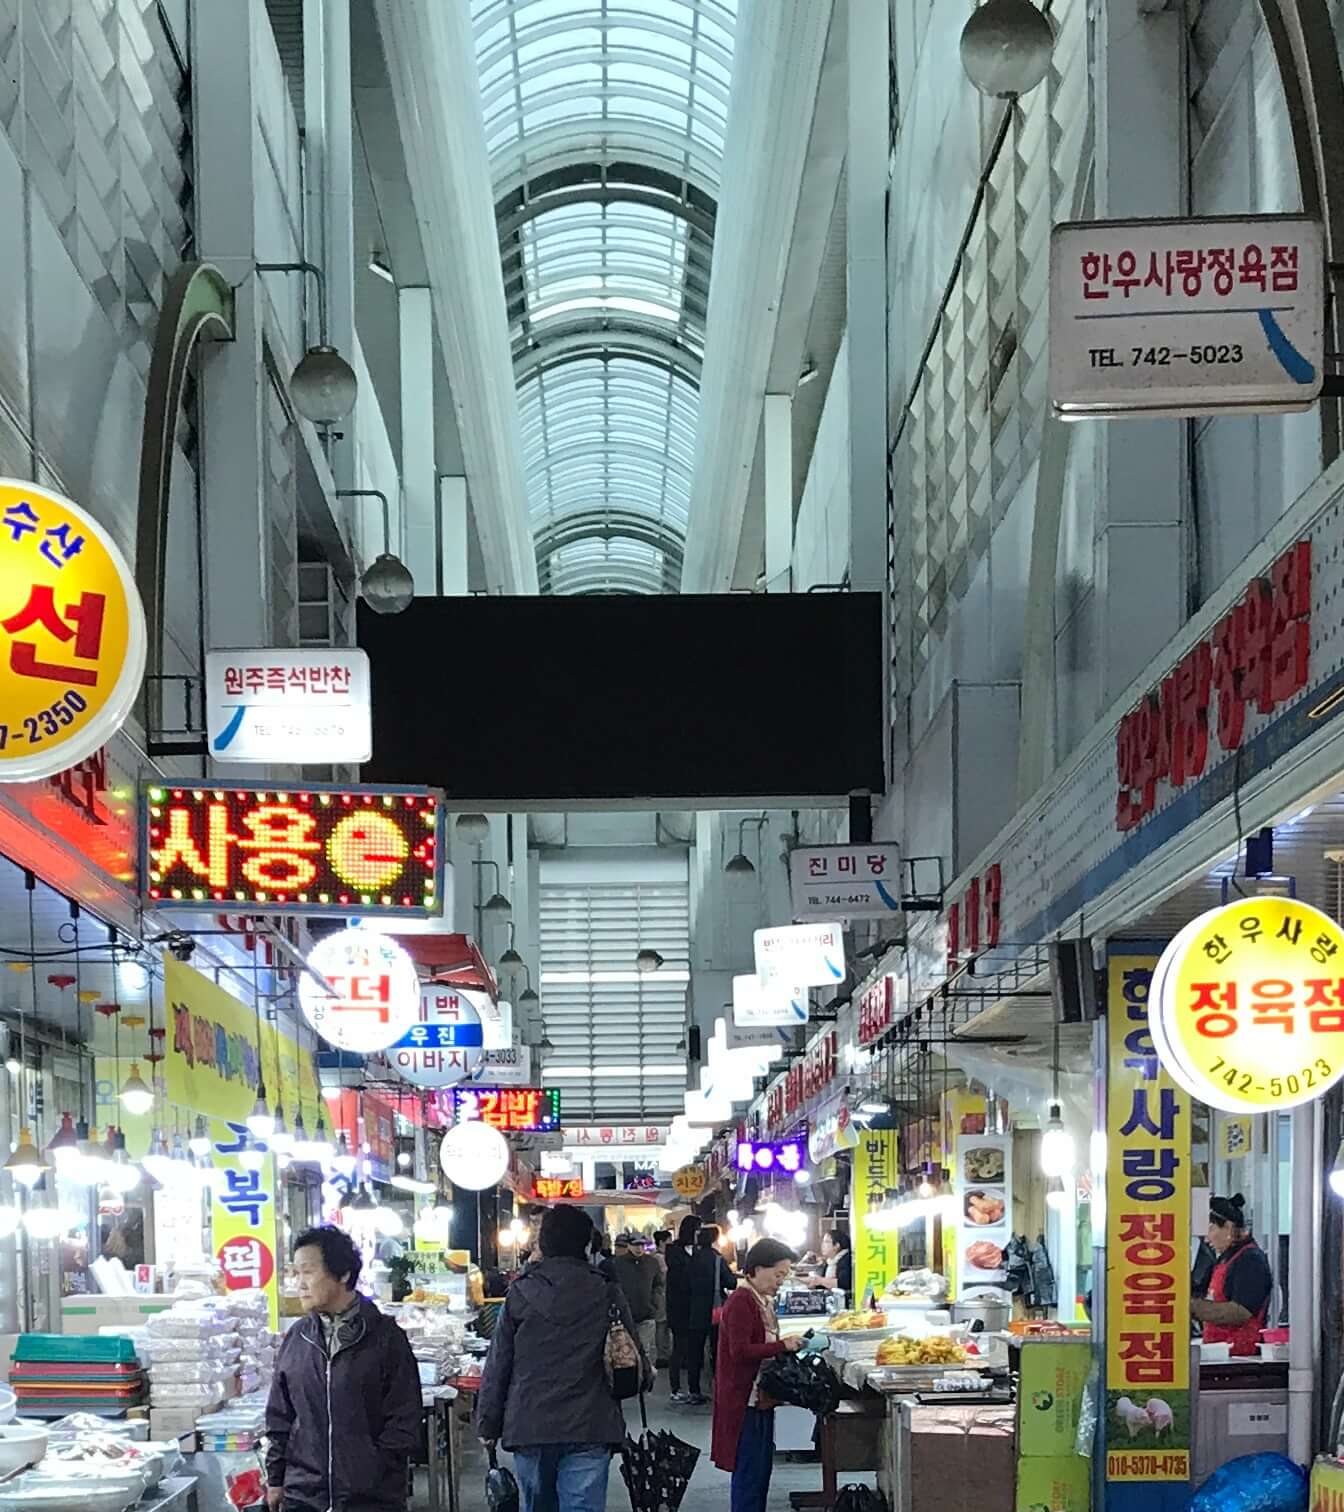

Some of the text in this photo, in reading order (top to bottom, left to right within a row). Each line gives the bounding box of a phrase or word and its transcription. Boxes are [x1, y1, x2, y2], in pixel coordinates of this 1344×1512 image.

[1080, 244, 1300, 300] 한우사랑정육점
[1089, 344, 1244, 368] TEL. 742-5023
[223, 665, 352, 696] 원주즉석반찬
[158, 804, 323, 890] 사용
[808, 854, 888, 877] 진미당
[1202, 915, 1338, 965] 한우사랑
[398, 1051, 468, 1073] 이바지
[1208, 1056, 1333, 1097] 742-5023
